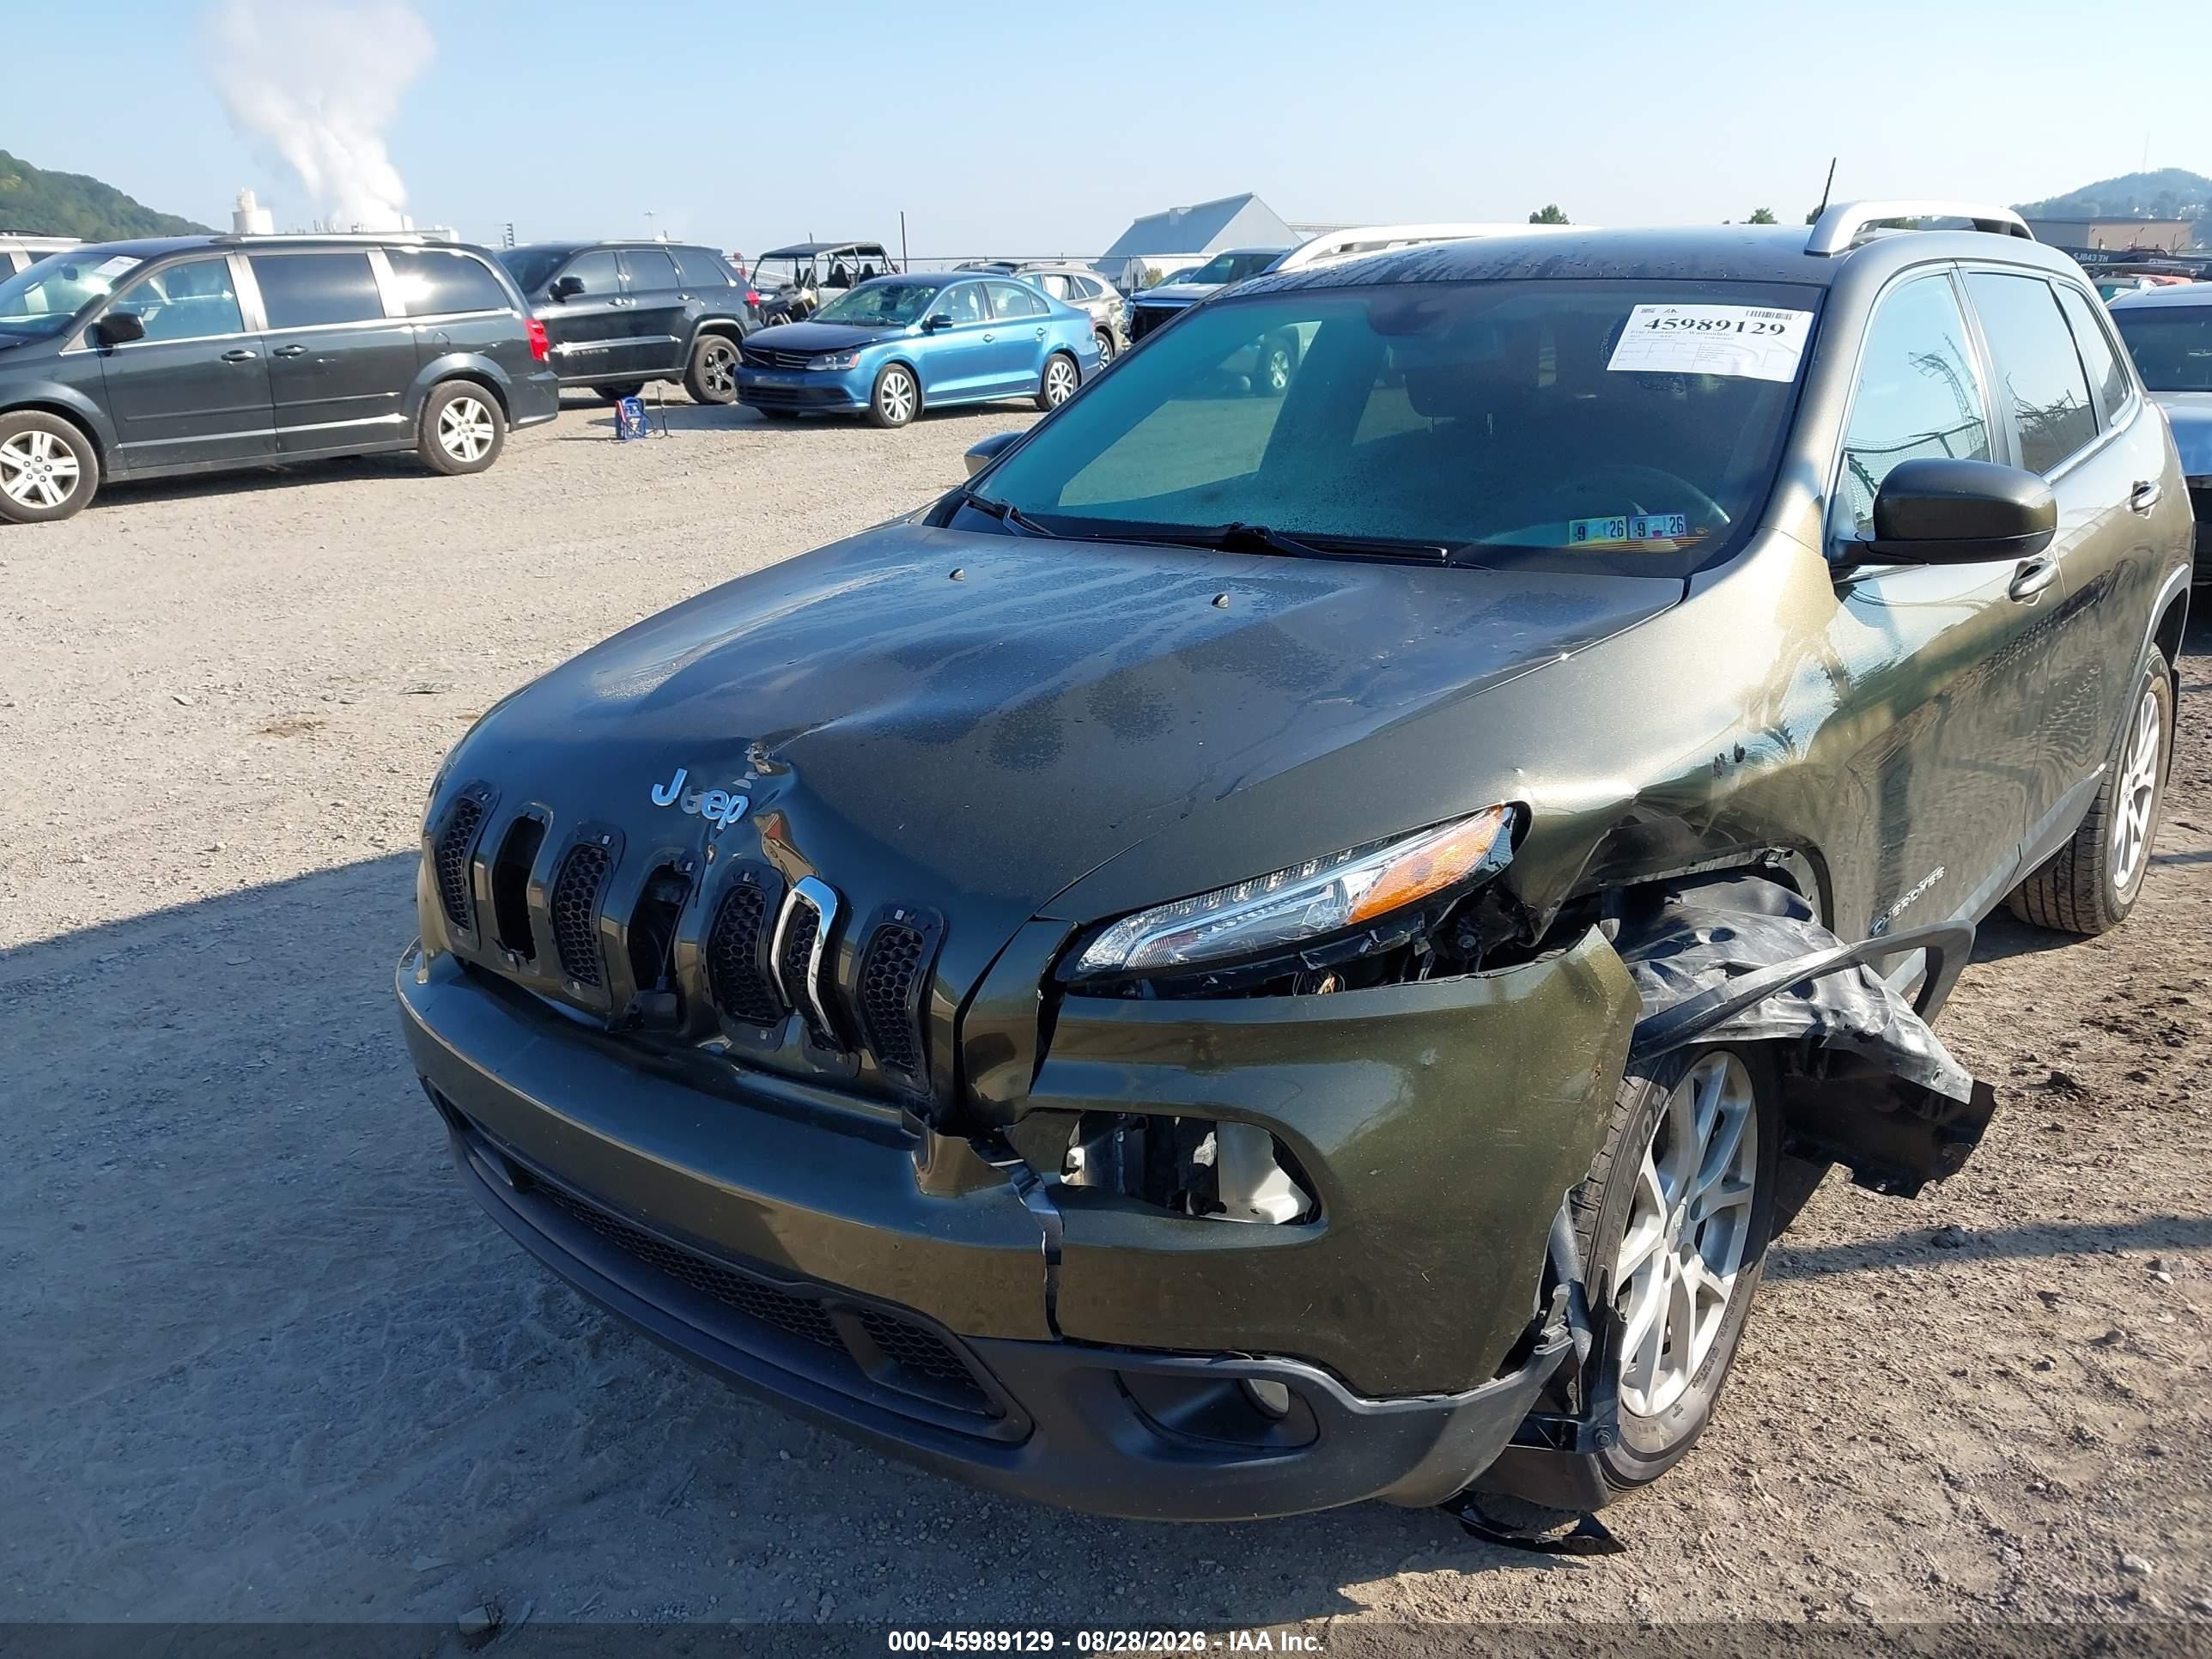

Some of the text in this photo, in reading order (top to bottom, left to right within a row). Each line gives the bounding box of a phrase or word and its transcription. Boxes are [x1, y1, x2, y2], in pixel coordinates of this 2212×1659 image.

[1644, 318, 1785, 336] 45989129
[1577, 526, 1586, 541] 9
[1609, 520, 1624, 538] 26
[1638, 521, 1646, 538] 9
[1669, 516, 1684, 534] 26
